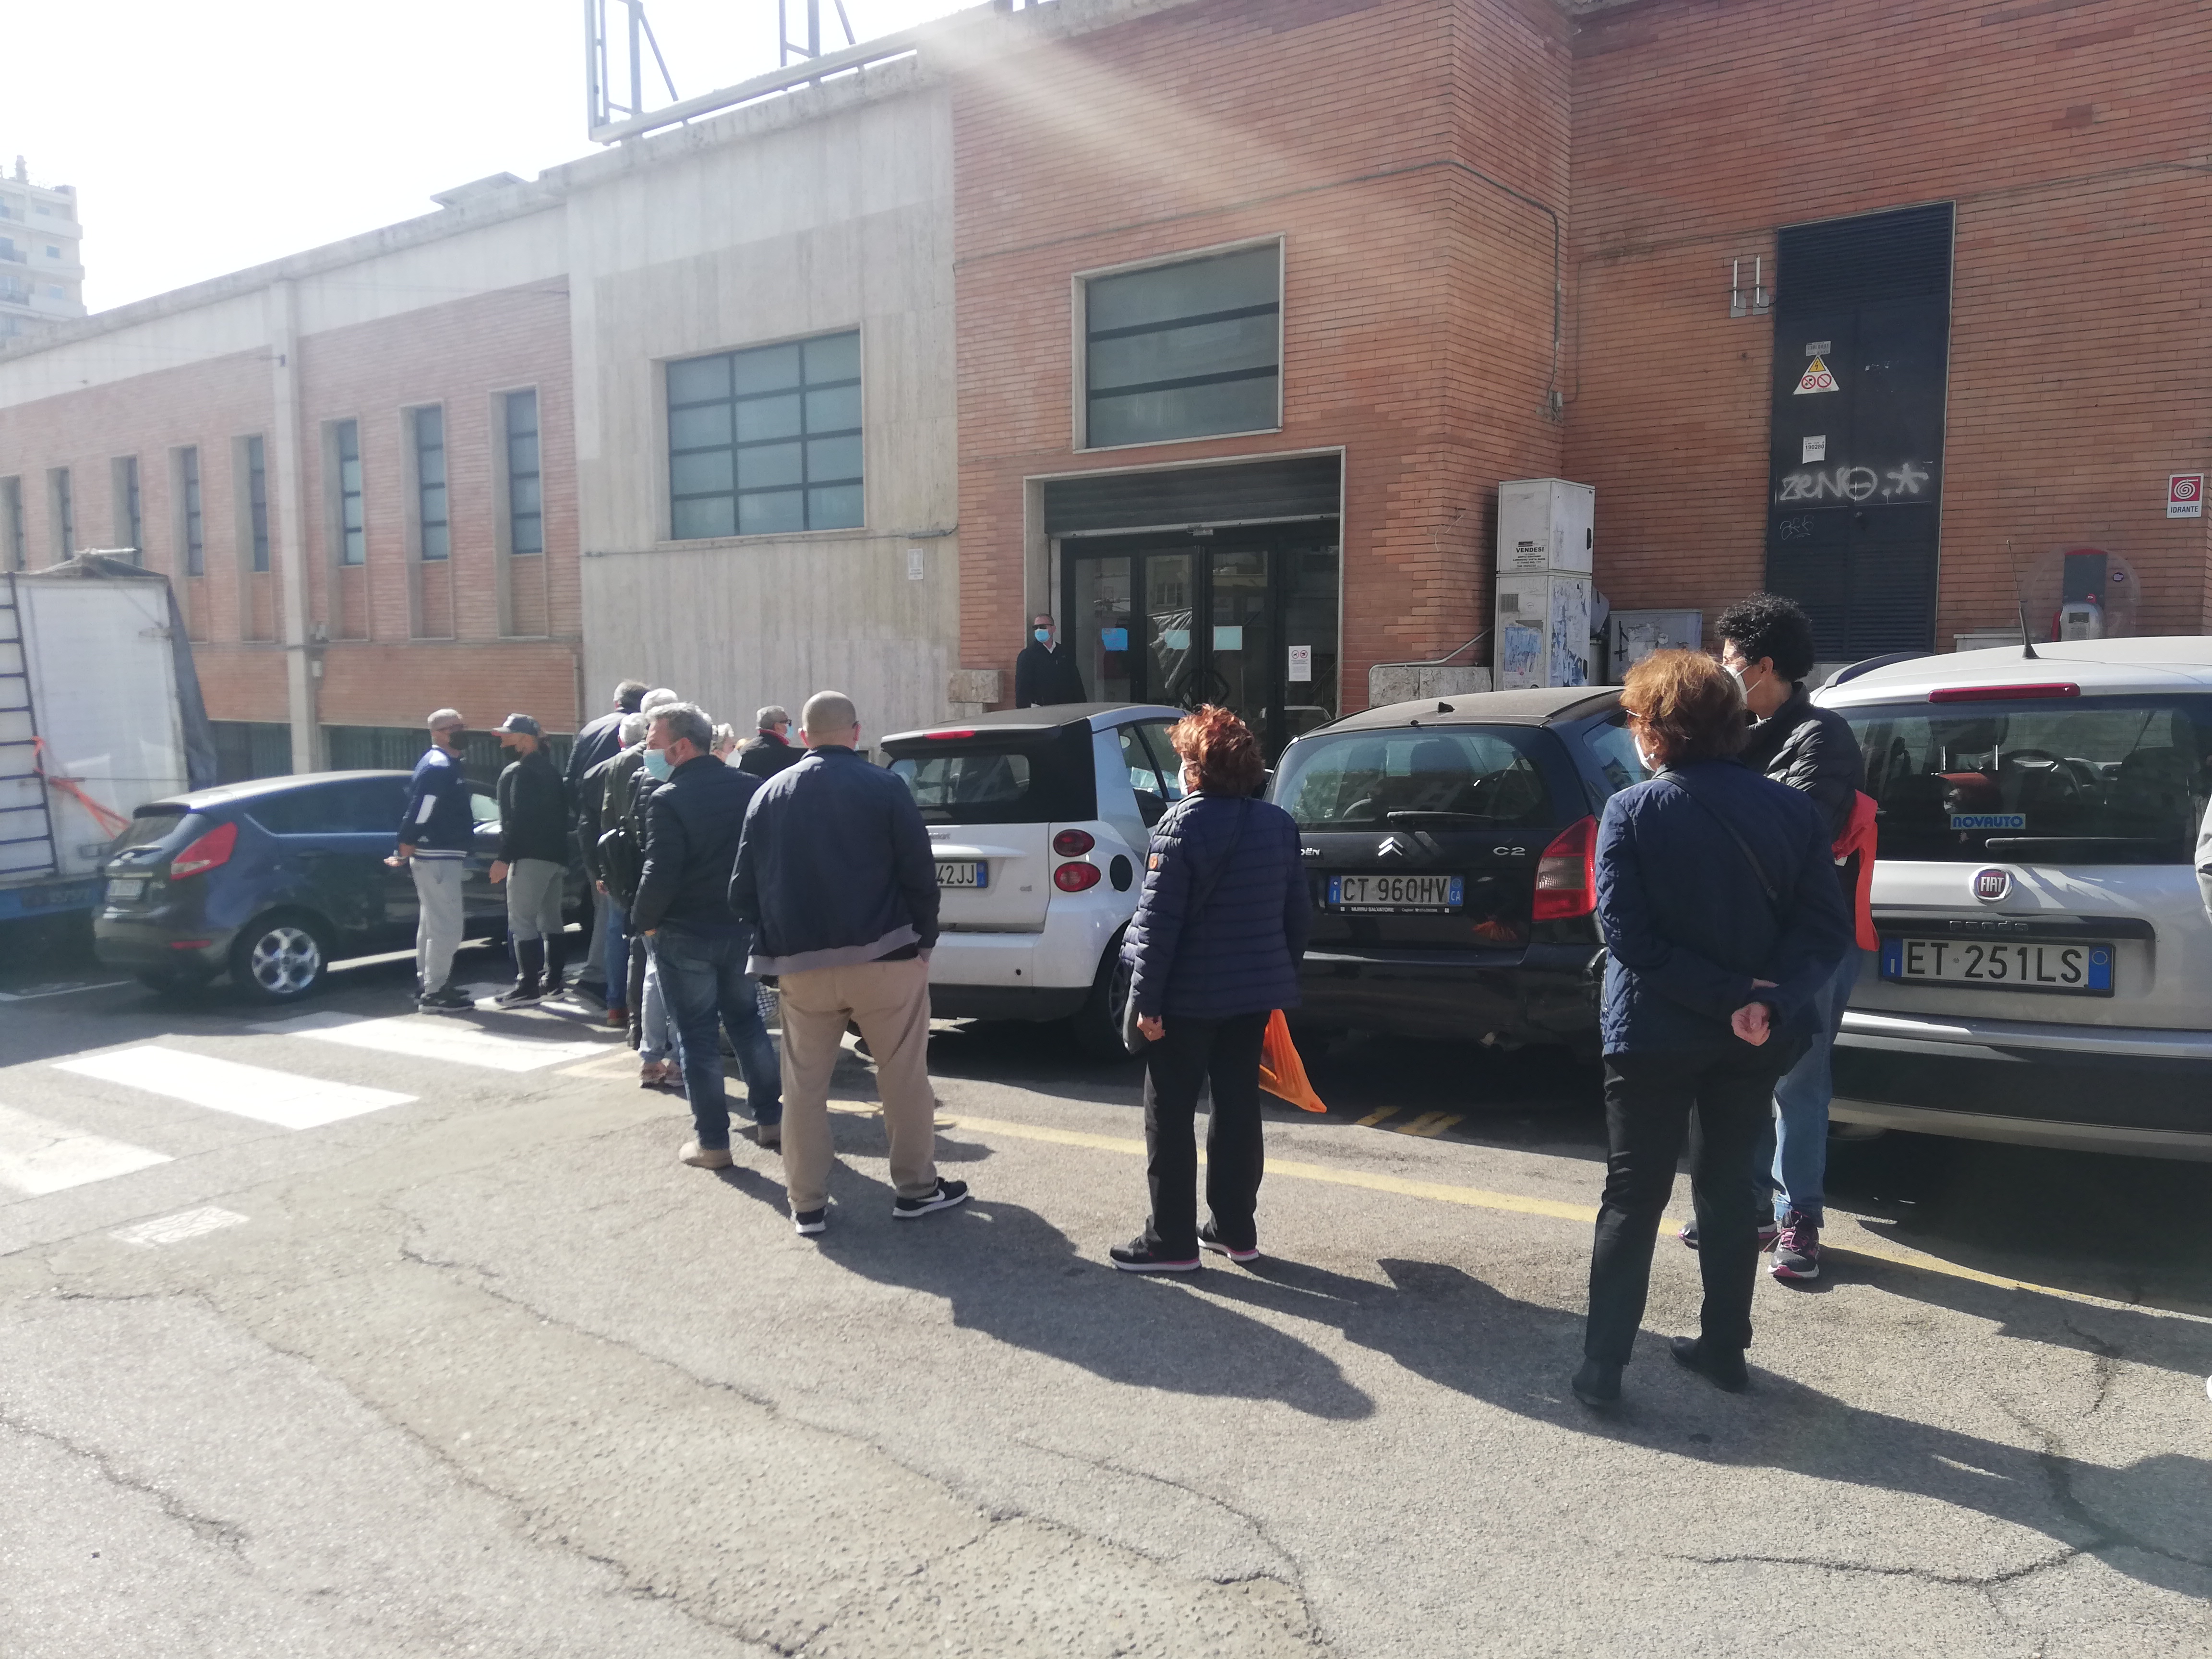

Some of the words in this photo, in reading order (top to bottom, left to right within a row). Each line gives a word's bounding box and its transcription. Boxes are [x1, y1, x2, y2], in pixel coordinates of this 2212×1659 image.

[1953, 816, 2023, 828] NOVAUTO
[1493, 847, 1526, 856] C2
[1343, 878, 1369, 902] CT
[1378, 878, 1447, 902] 960HV
[1980, 876, 2004, 892] FIAT
[1450, 891, 1461, 901] CA
[1949, 920, 2029, 931] panda
[1908, 942, 1949, 975] ET
[1964, 945, 2082, 984] 251LS
